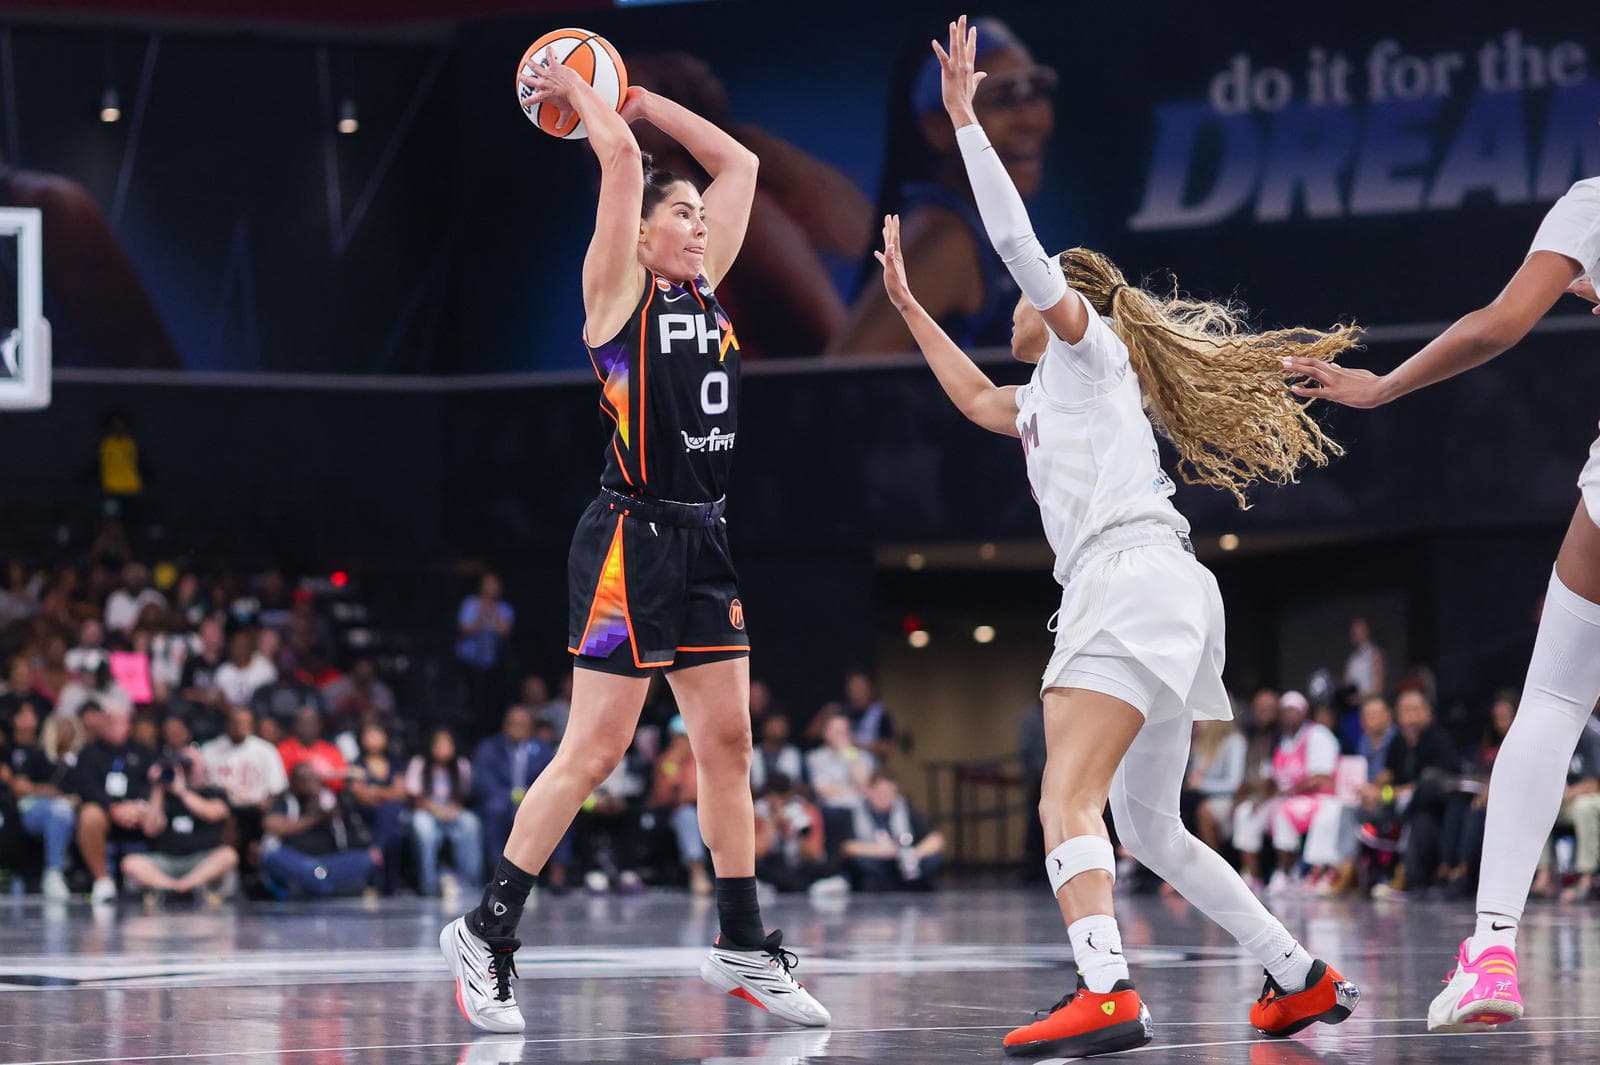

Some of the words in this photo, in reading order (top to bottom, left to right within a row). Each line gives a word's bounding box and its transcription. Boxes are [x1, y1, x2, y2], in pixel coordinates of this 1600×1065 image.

[1209, 52, 1293, 115] do
[1306, 46, 1354, 108] it
[1367, 38, 1465, 101] for
[1478, 28, 1588, 93] the
[700, 371, 729, 415] 0
